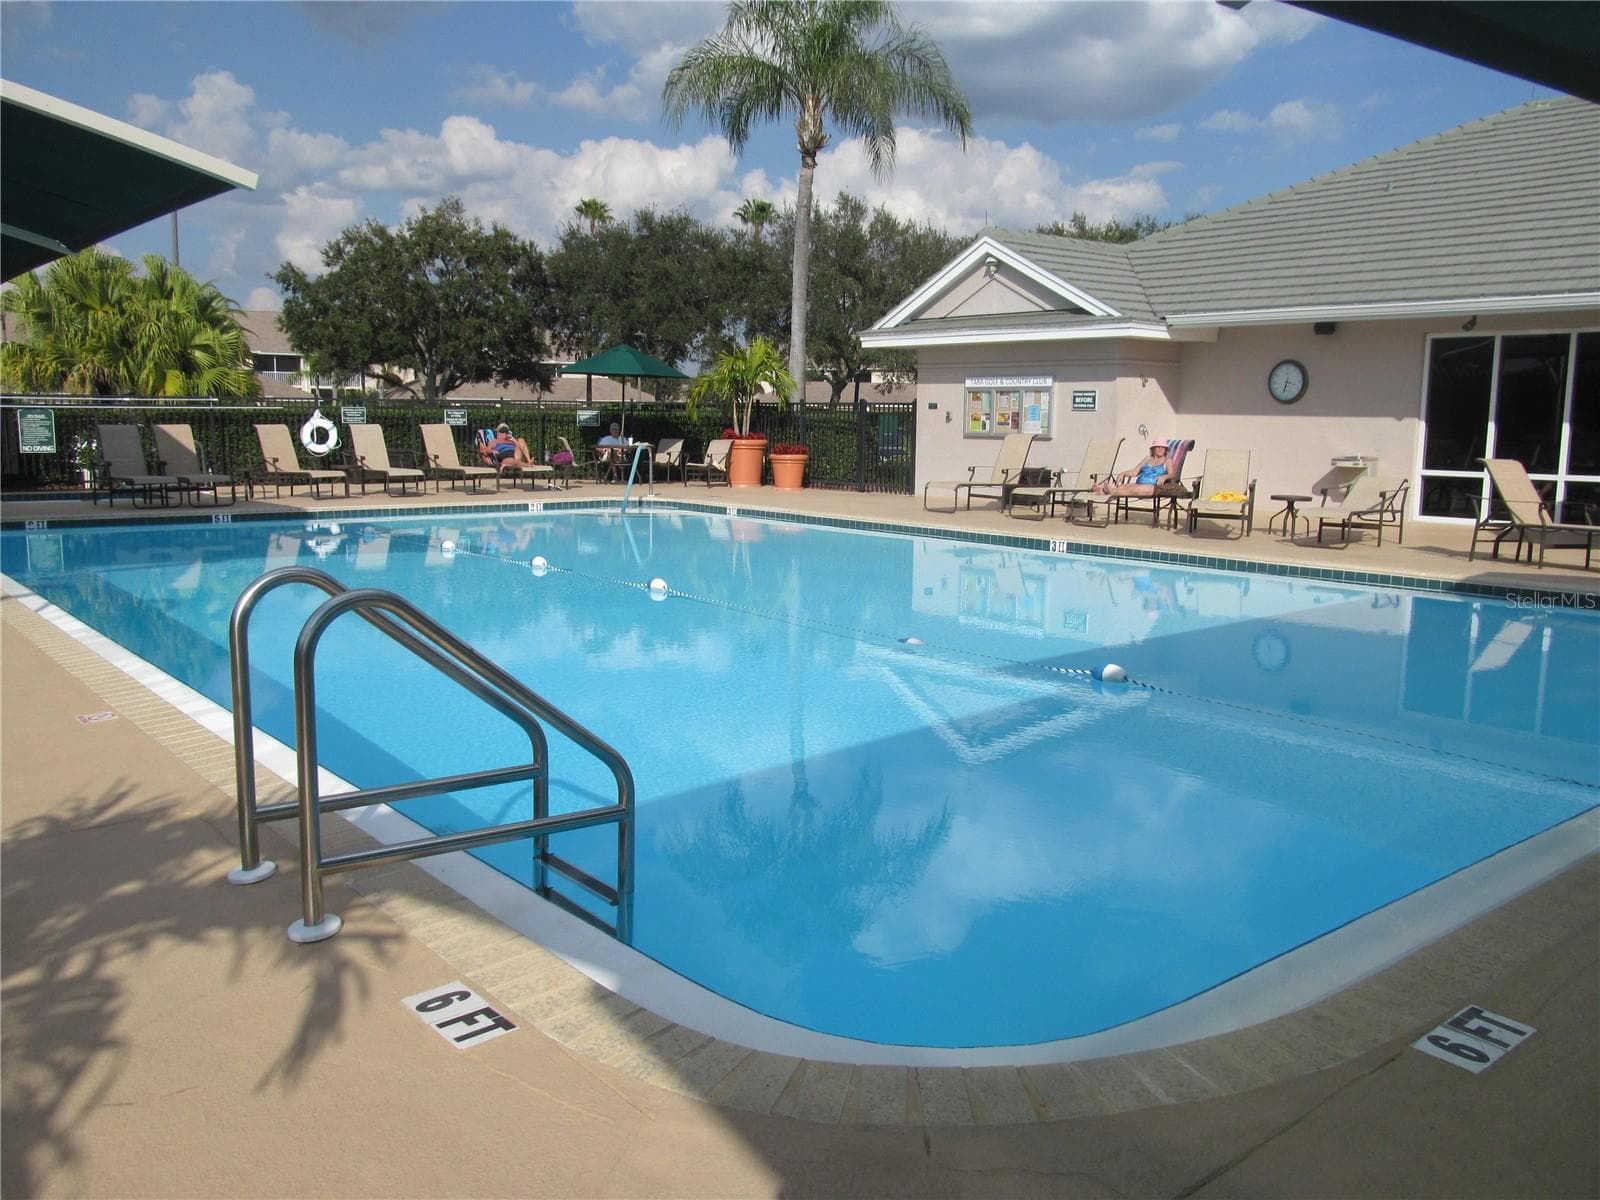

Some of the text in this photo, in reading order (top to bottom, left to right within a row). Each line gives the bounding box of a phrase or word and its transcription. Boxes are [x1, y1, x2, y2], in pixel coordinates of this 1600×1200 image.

[1051, 540, 1056, 552] 3
[415, 990, 518, 1043] 6 FT
[1426, 1006, 1528, 1063] 6 FT
